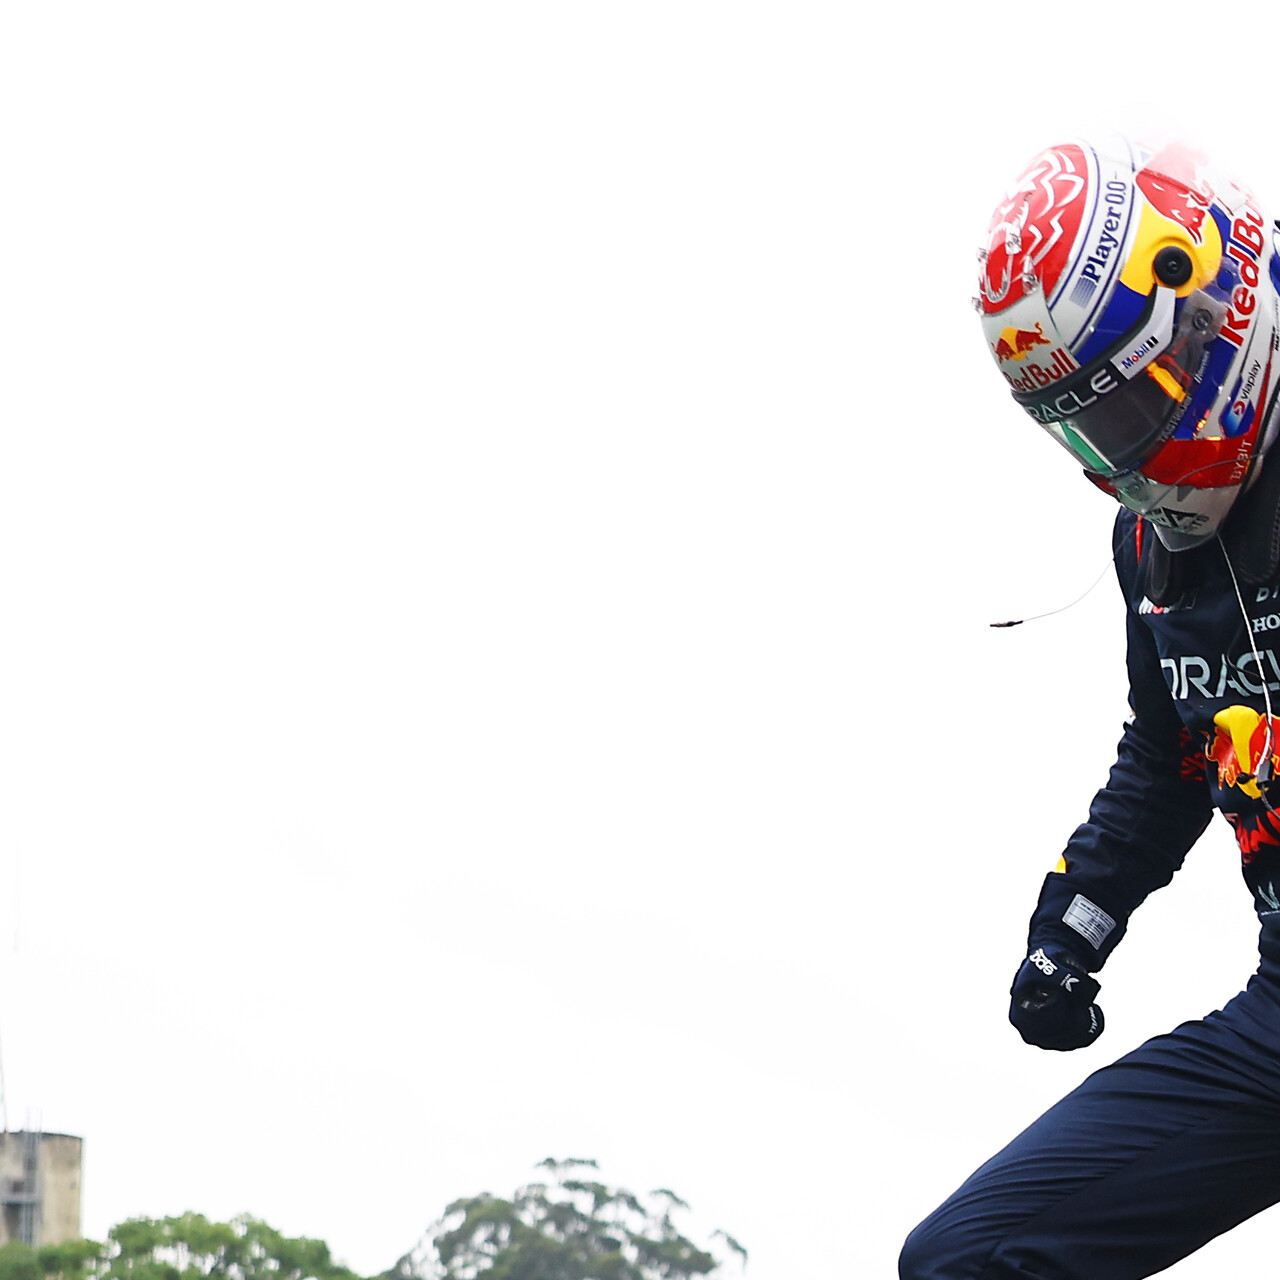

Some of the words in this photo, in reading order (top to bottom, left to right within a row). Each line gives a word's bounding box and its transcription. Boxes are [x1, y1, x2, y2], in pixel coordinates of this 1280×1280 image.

[1081, 207, 1122, 284] Player
[1220, 245, 1259, 347] Red
[1029, 347, 1077, 387] Bull
[1121, 343, 1149, 370] Mobil
[1026, 368, 1119, 423] RACLE
[1241, 359, 1262, 400] viaplay
[1231, 439, 1253, 480] BYBIT
